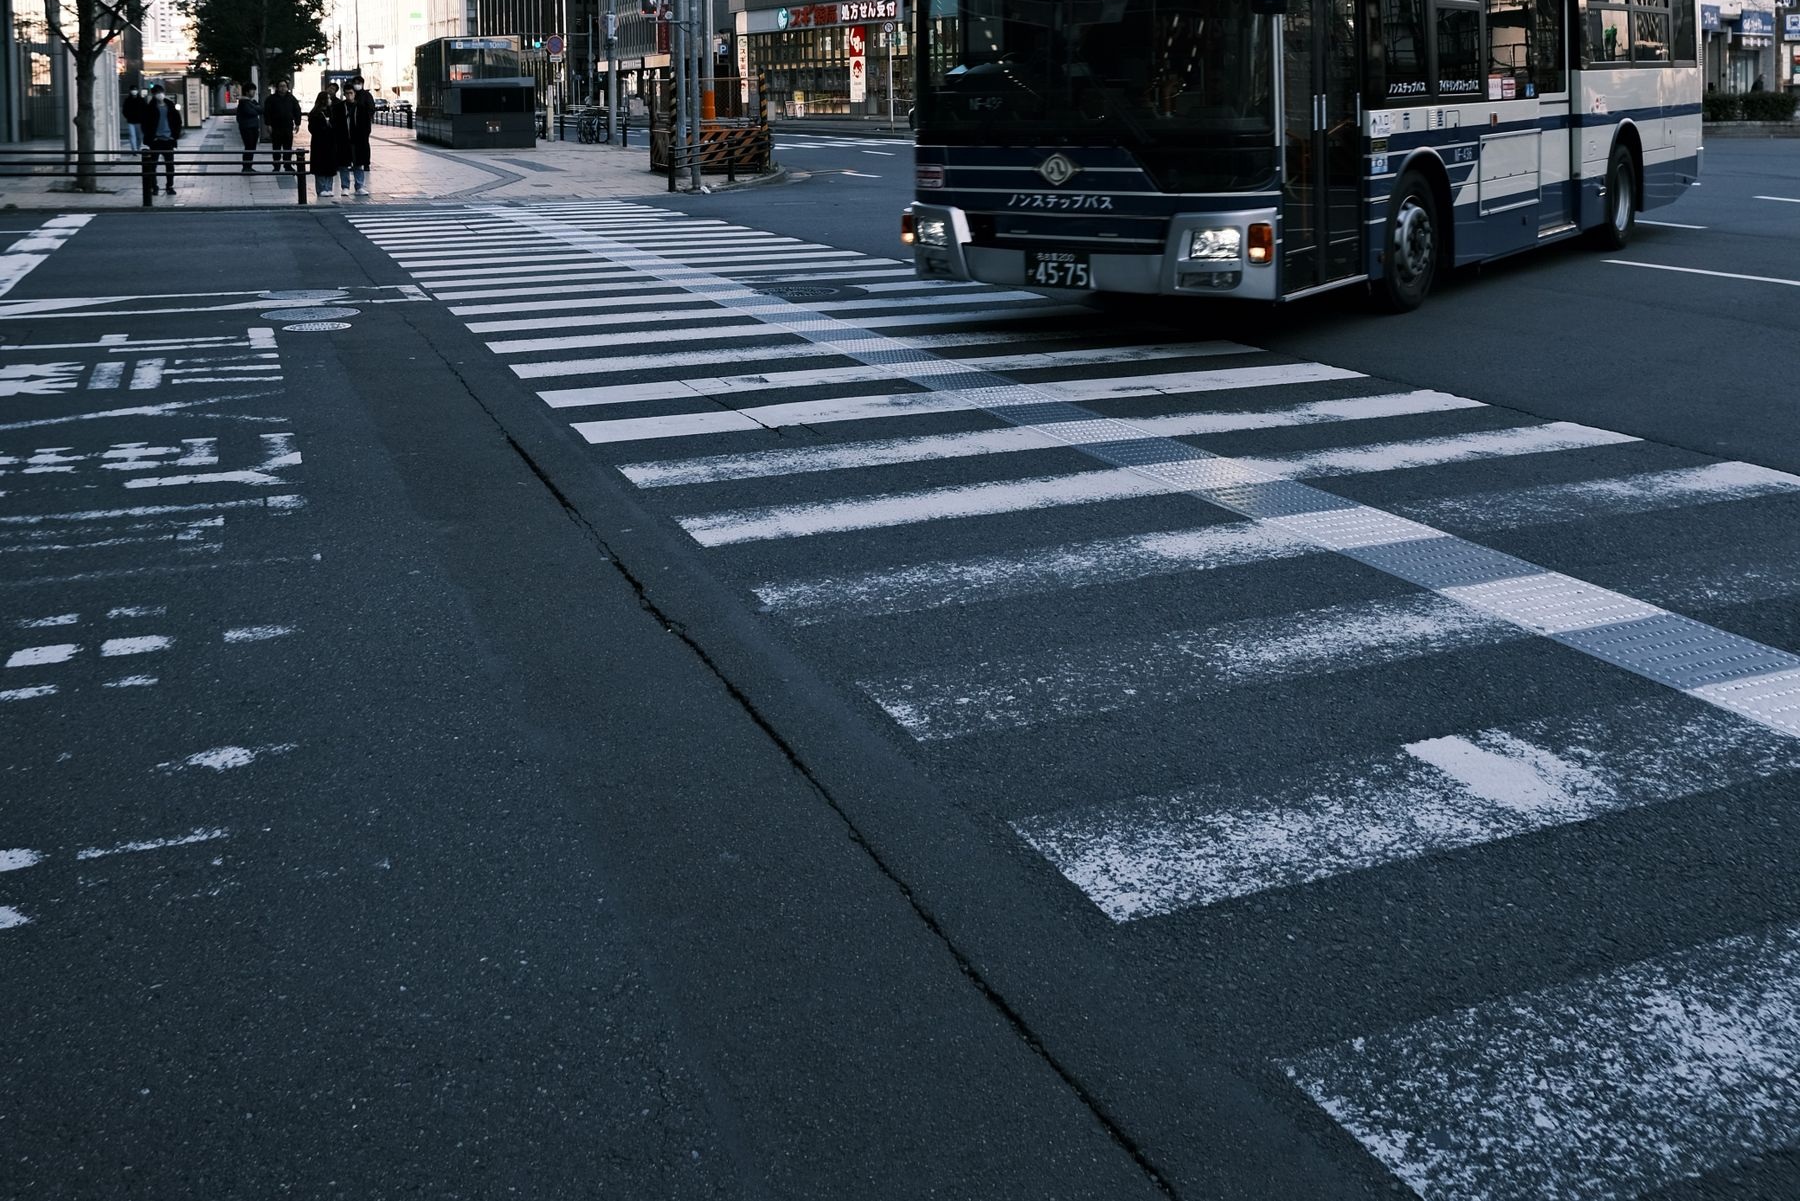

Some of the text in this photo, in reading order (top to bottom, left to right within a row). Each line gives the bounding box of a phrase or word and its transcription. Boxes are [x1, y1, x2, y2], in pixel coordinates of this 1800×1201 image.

[790, 1, 896, 28] スギ薬局 処方せん受付
[1388, 81, 1426, 94] ノンステップバス
[1007, 194, 1114, 210] ノンステップバス
[1036, 262, 1088, 286] 45-75
